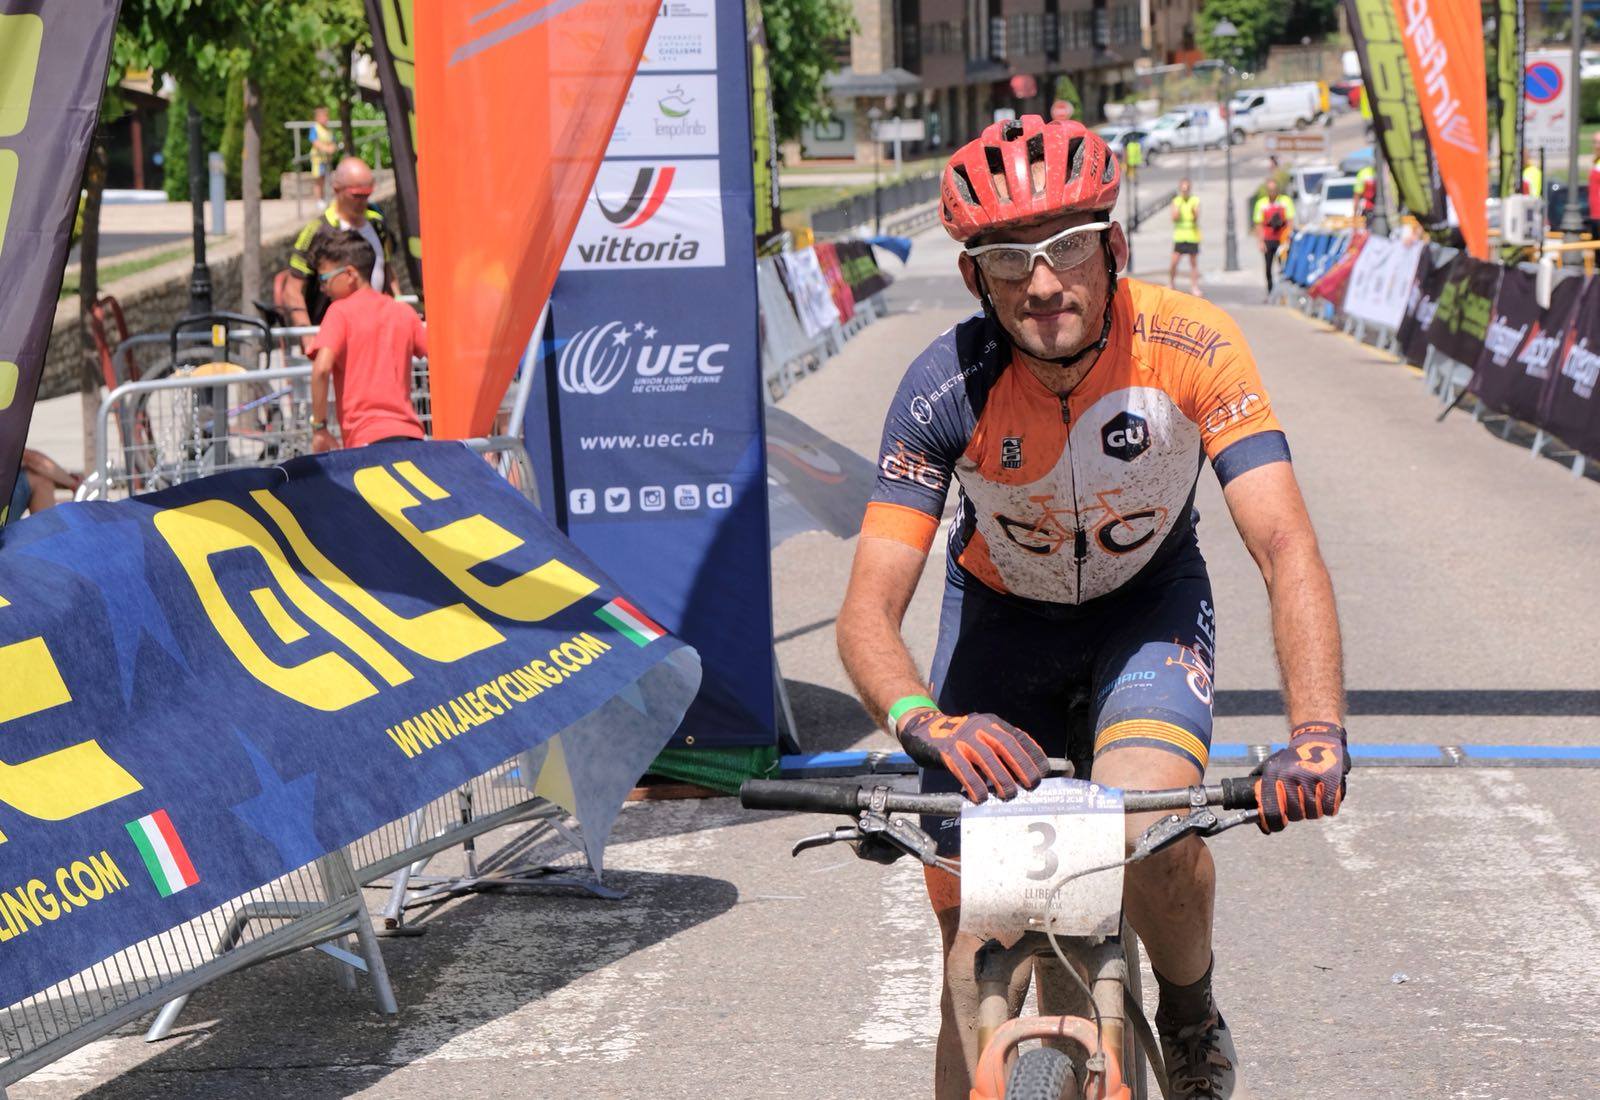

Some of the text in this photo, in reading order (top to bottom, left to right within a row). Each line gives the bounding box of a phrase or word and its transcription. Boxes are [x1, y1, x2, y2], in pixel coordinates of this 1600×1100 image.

[577, 233, 700, 263] vittoria
[636, 343, 730, 376] UEC
[632, 384, 688, 393] DE CYCLISME
[634, 377, 663, 386] UNION
[580, 428, 714, 450] www.uec.ch
[1107, 426, 1144, 448] GU
[386, 632, 612, 758] WWW.ALECYCLING.COM
[1026, 822, 1059, 880] 3
